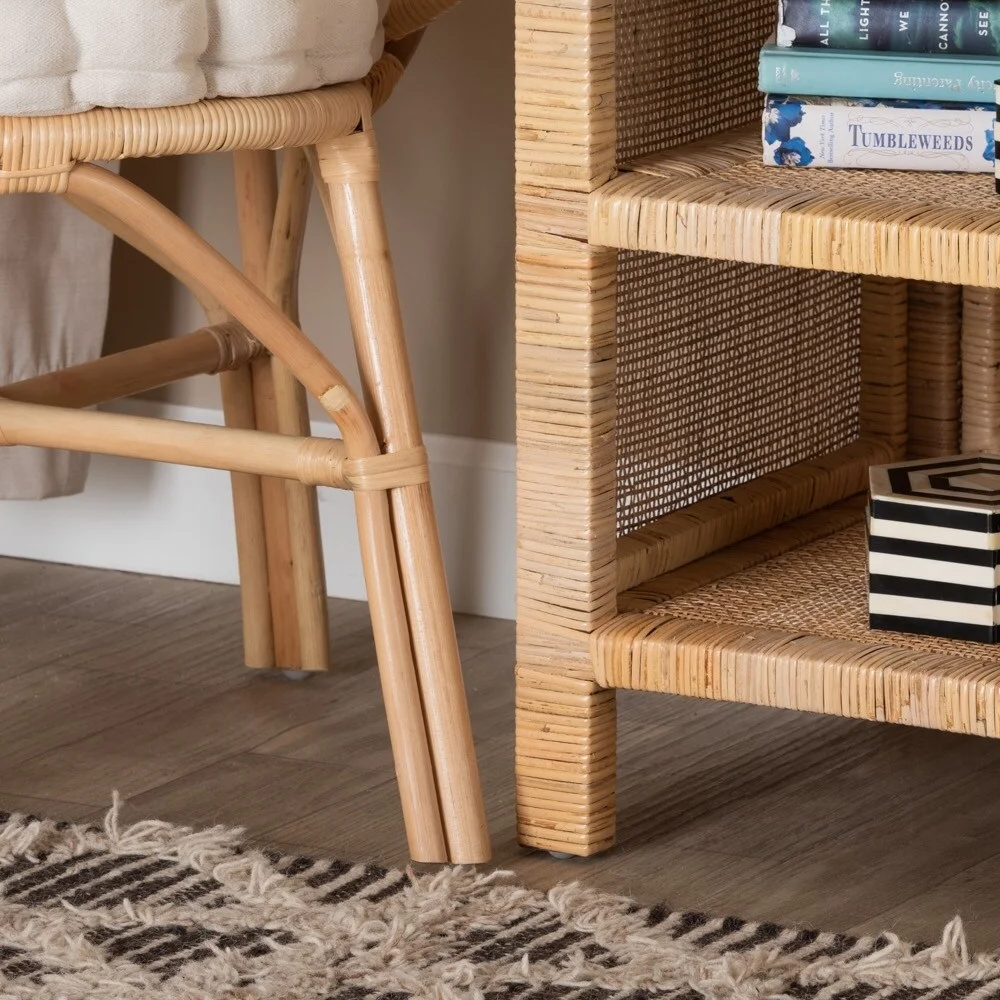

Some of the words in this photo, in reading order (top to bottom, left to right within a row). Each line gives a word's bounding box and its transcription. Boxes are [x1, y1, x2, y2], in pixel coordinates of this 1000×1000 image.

[820, 21, 830, 46] ALL
[898, 11, 910, 32] WE
[978, 11, 989, 36] SEE
[893, 71, 962, 92] Parenting
[827, 134, 835, 164] Bestselling
[848, 123, 974, 151] TUMBLEWEEDS
